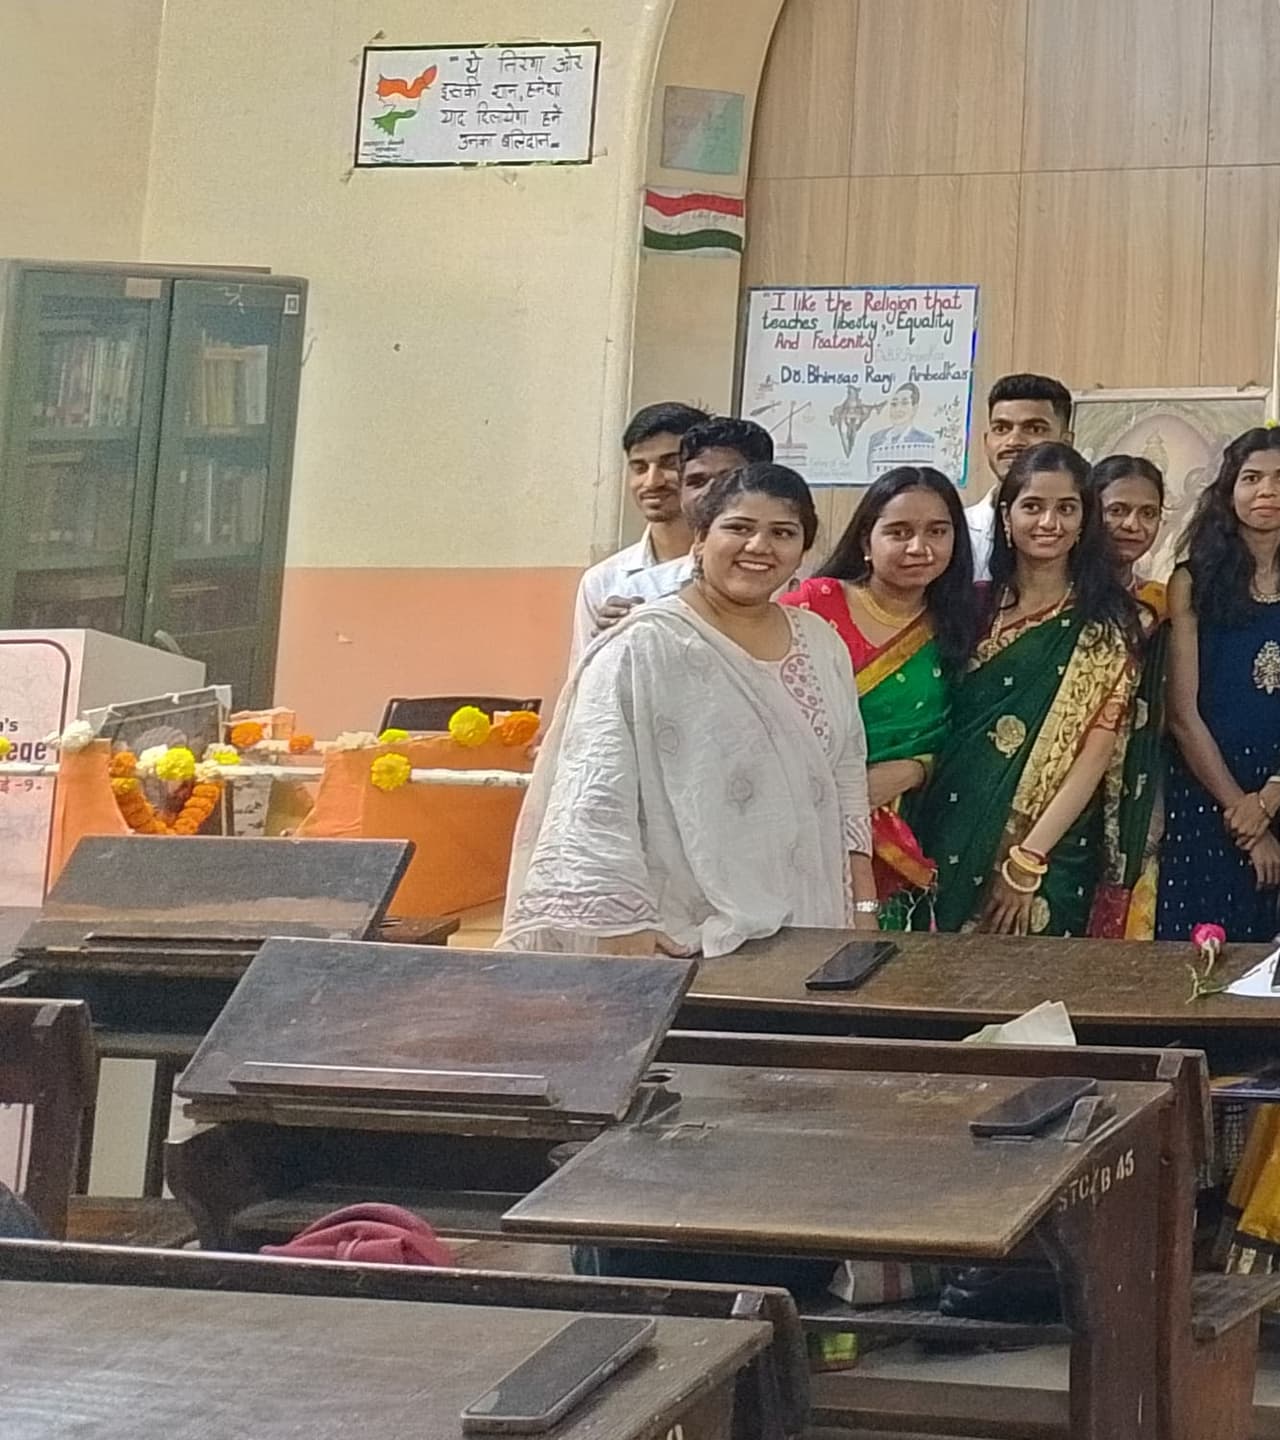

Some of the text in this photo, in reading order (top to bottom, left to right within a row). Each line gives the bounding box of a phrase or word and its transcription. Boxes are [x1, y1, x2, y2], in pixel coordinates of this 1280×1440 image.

[440, 108, 468, 126] याद
[793, 292, 817, 312] like
[826, 291, 853, 311] the
[864, 292, 918, 324] Religion
[924, 290, 963, 311] that
[762, 312, 819, 330] teaches
[896, 311, 955, 345] Equality
[775, 331, 800, 349] And
[908, 359, 969, 382] Ambedkar
[1115, 1148, 1135, 1179] 45
